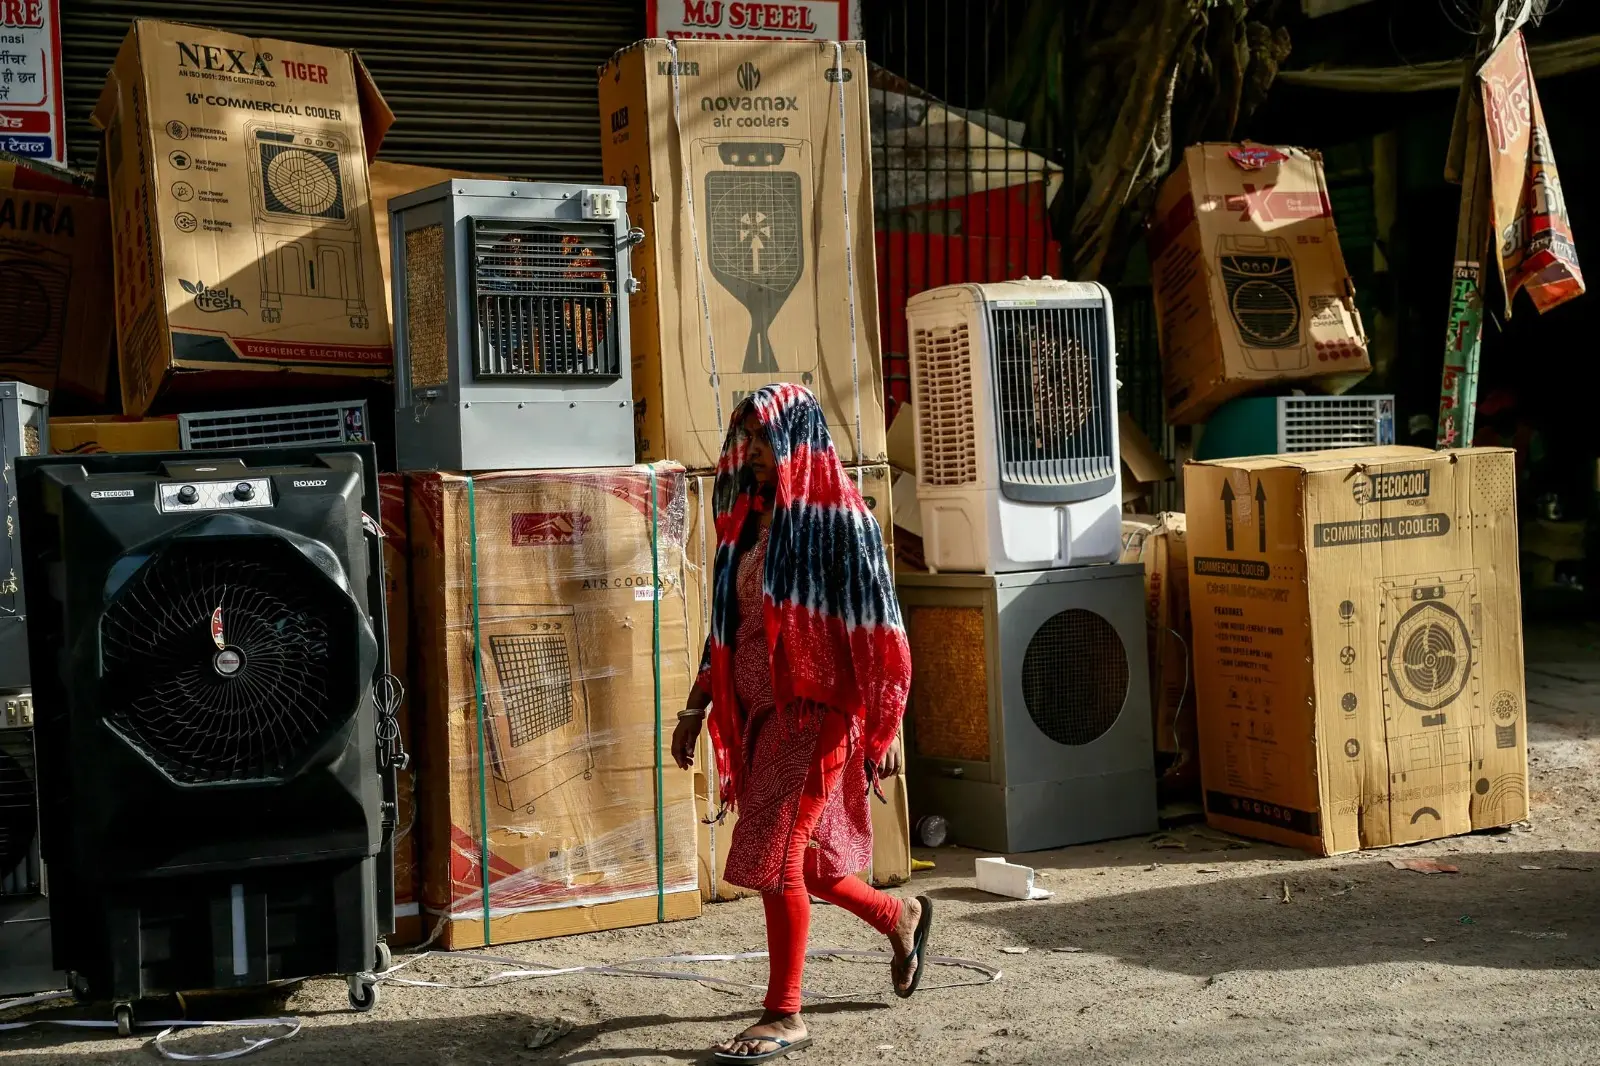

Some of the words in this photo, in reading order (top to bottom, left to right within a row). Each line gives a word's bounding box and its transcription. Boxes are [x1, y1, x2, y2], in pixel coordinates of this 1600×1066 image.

[683, 0, 724, 25] MJ
[729, 2, 815, 32] STEEL
[17, 72, 36, 84] छत
[281, 60, 329, 85] TIGER
[205, 95, 303, 116] COMMERCIAL
[304, 105, 342, 121] COOLER
[700, 95, 799, 112] novamax
[713, 114, 732, 128] air
[736, 114, 790, 128] coolers
[203, 287, 229, 298] feel
[198, 293, 242, 309] fresh
[247, 345, 306, 357] EXPERIENCE
[309, 348, 356, 360] ELECTRIC
[357, 351, 383, 360] ZONE
[1375, 473, 1428, 498] EECOCOOL
[1322, 519, 1396, 542] COMMERCIAL
[1398, 518, 1440, 536] COOLER
[1197, 560, 1240, 575] COMMERCIAL
[1241, 563, 1265, 577] COOLER
[582, 579, 608, 589] AIR
[1214, 606, 1243, 617] FEATURES
